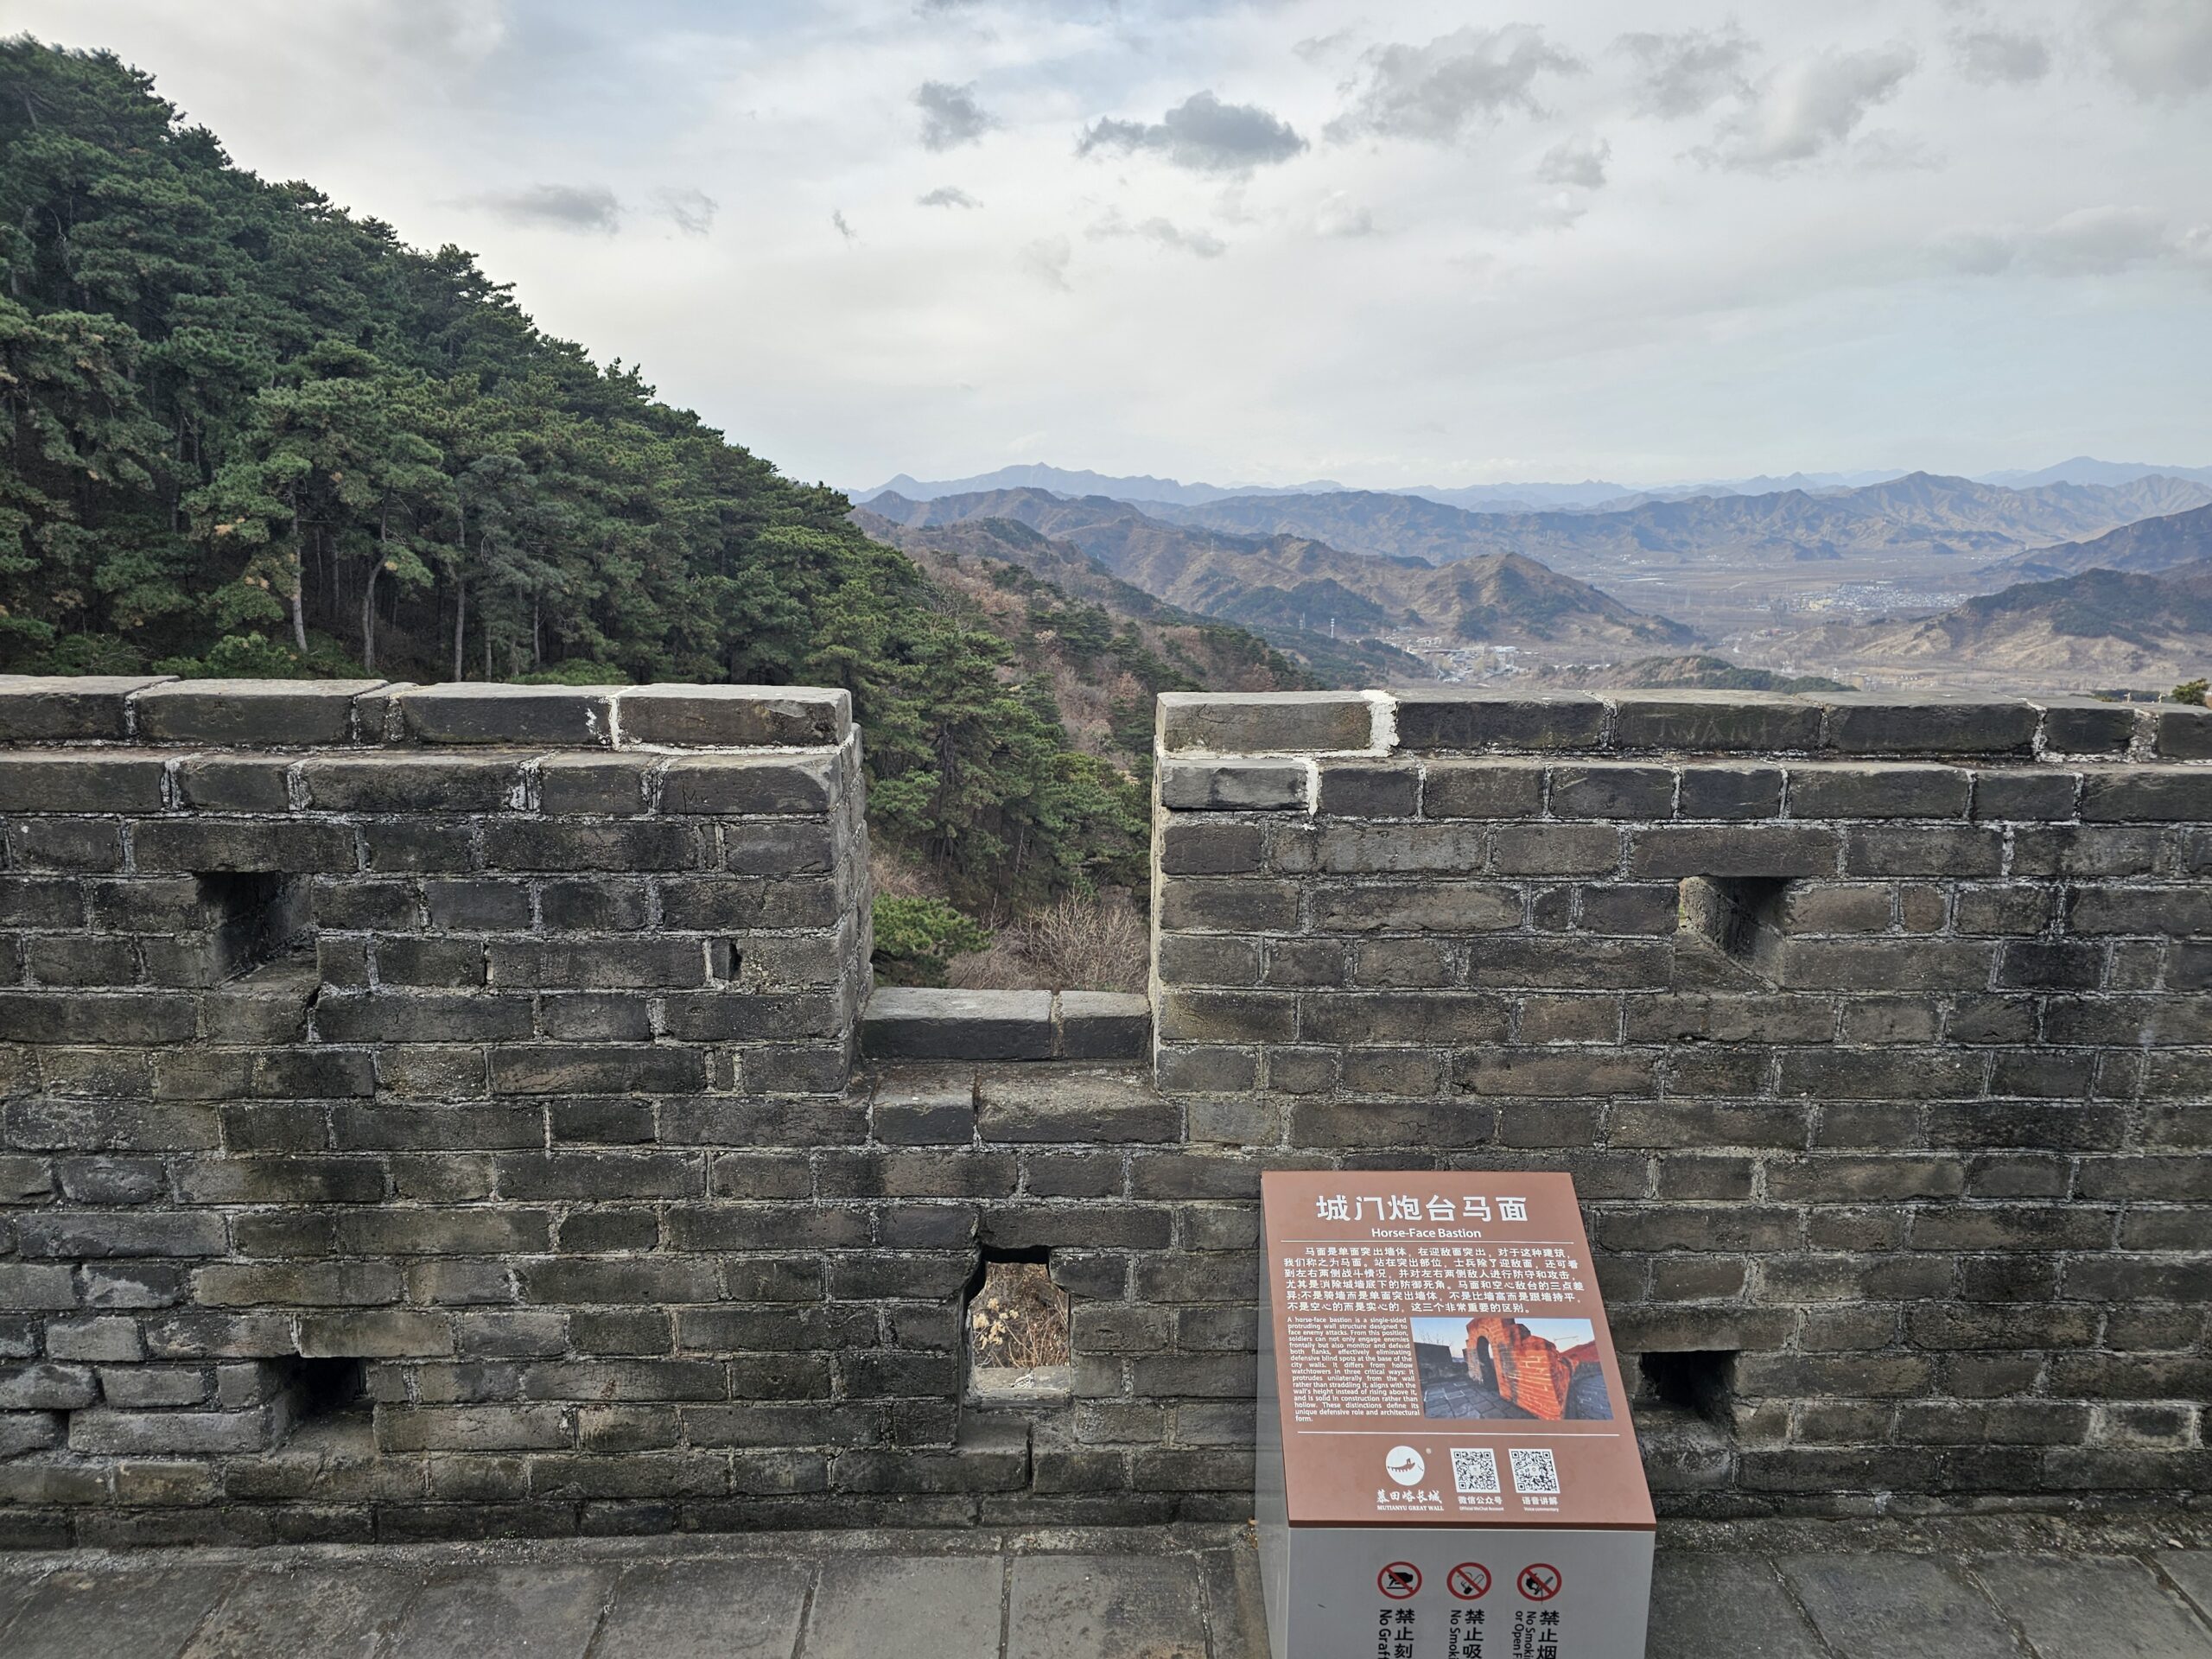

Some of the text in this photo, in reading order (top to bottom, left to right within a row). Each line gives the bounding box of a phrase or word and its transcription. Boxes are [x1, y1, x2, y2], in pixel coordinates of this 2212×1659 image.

[1316, 1194, 1528, 1222] 城门炮台马面
[1371, 1228, 1482, 1238] Horse-Face Bastion
[1377, 1489, 1442, 1503] 慕田峪长城
[1458, 1496, 1503, 1504] 微信公众号
[1522, 1497, 1558, 1505] 语音讲解
[1379, 1609, 1392, 1626] No
[1451, 1610, 1462, 1625] No
[1515, 1611, 1523, 1622] or
[1526, 1611, 1536, 1624] No
[1394, 1608, 1415, 1659] 禁止刻
[1463, 1609, 1485, 1659] 禁止吸
[1511, 1623, 1524, 1650] Open
[1537, 1610, 1560, 1659] 禁止烟
